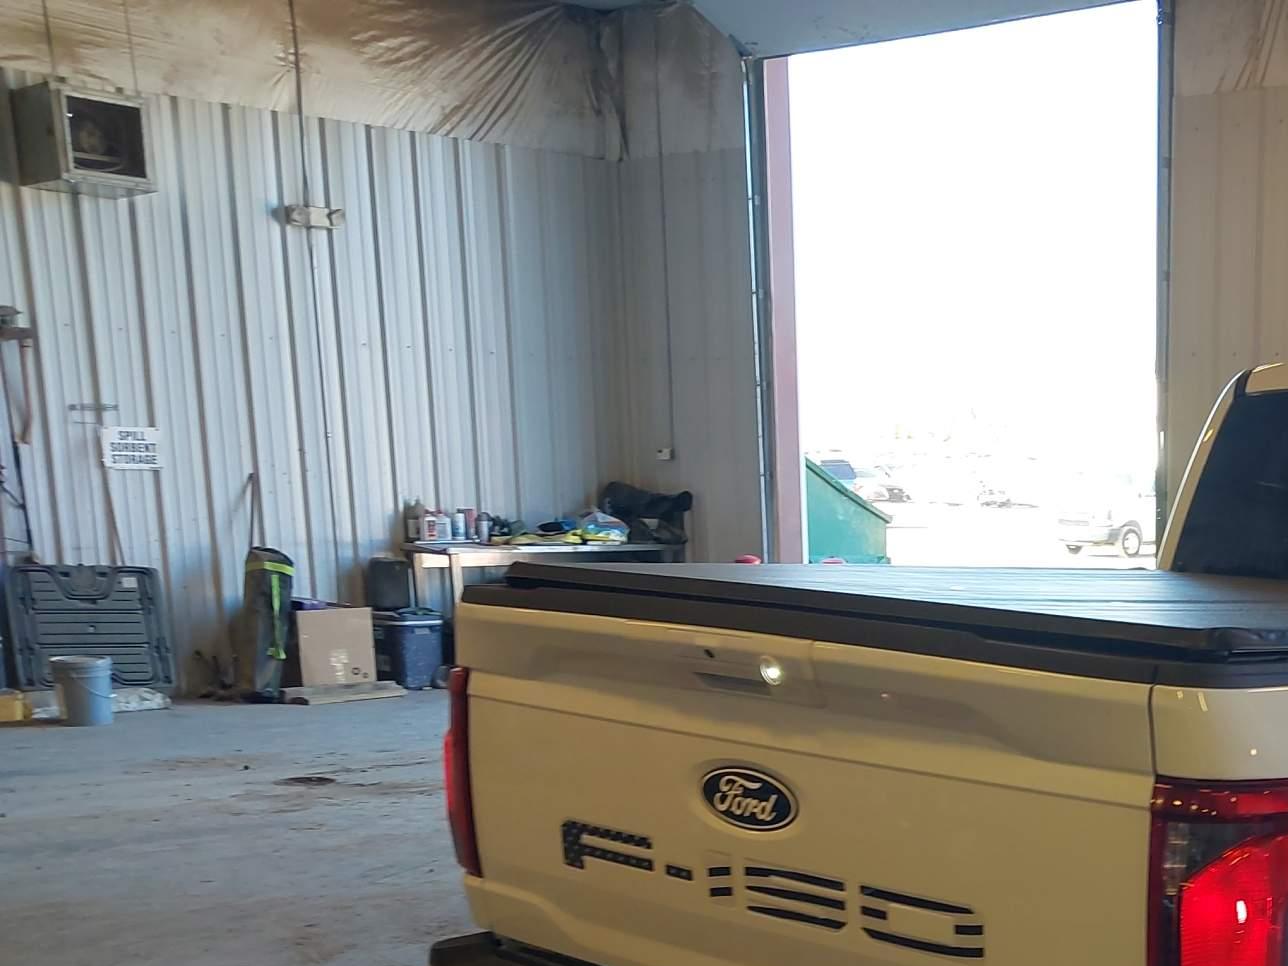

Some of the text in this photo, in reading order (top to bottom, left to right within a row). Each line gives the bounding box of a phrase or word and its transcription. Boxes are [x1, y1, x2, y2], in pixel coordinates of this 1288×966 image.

[117, 430, 147, 441] SPILL
[109, 442, 157, 453] SORBENT
[110, 454, 158, 465] STORAGE
[714, 774, 778, 822] Ford
[560, 818, 986, 960] F-150
